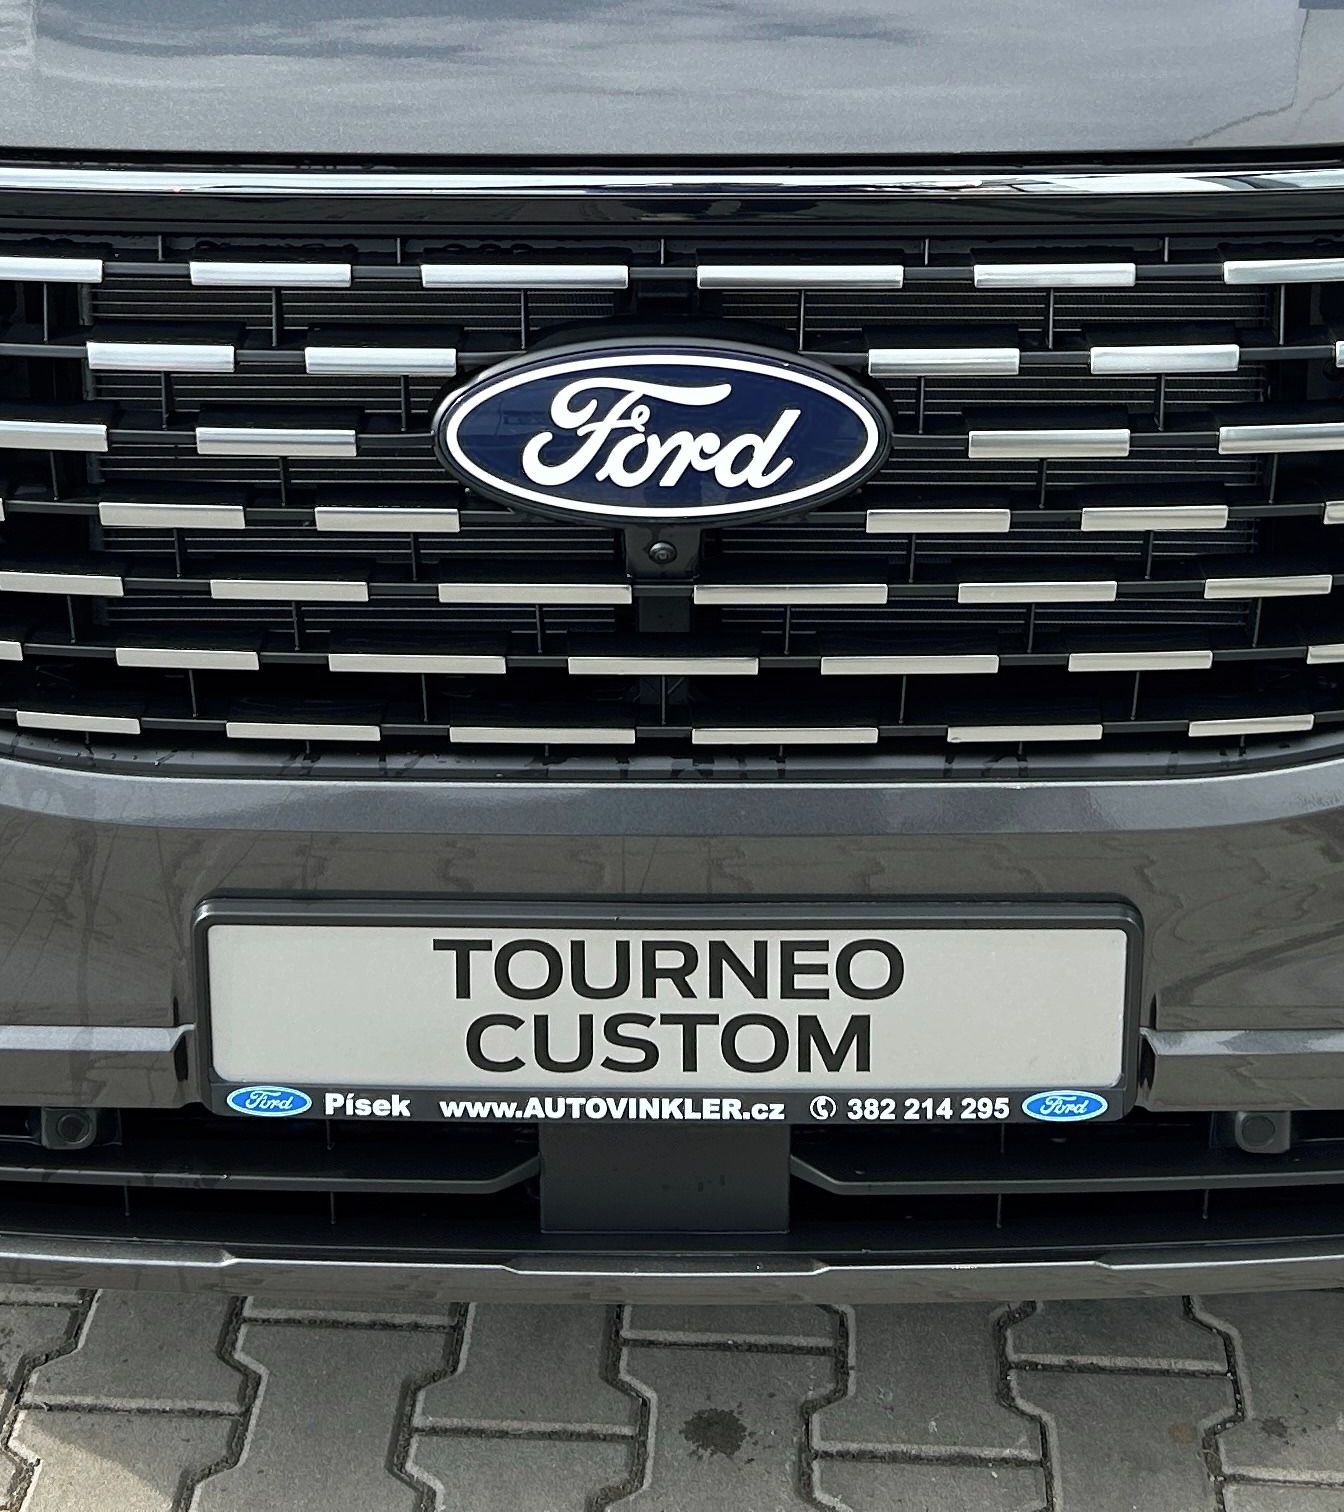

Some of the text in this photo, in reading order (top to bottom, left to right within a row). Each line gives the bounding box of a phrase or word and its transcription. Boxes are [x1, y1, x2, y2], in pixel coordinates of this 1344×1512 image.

[522, 376, 802, 489] Ford
[433, 938, 905, 1000] TOURNEO
[465, 1012, 871, 1074] CUSTOM
[245, 1090, 1090, 1120] Ford Písek www.AUTOVINKLER.cz 382 214 295 Ford
